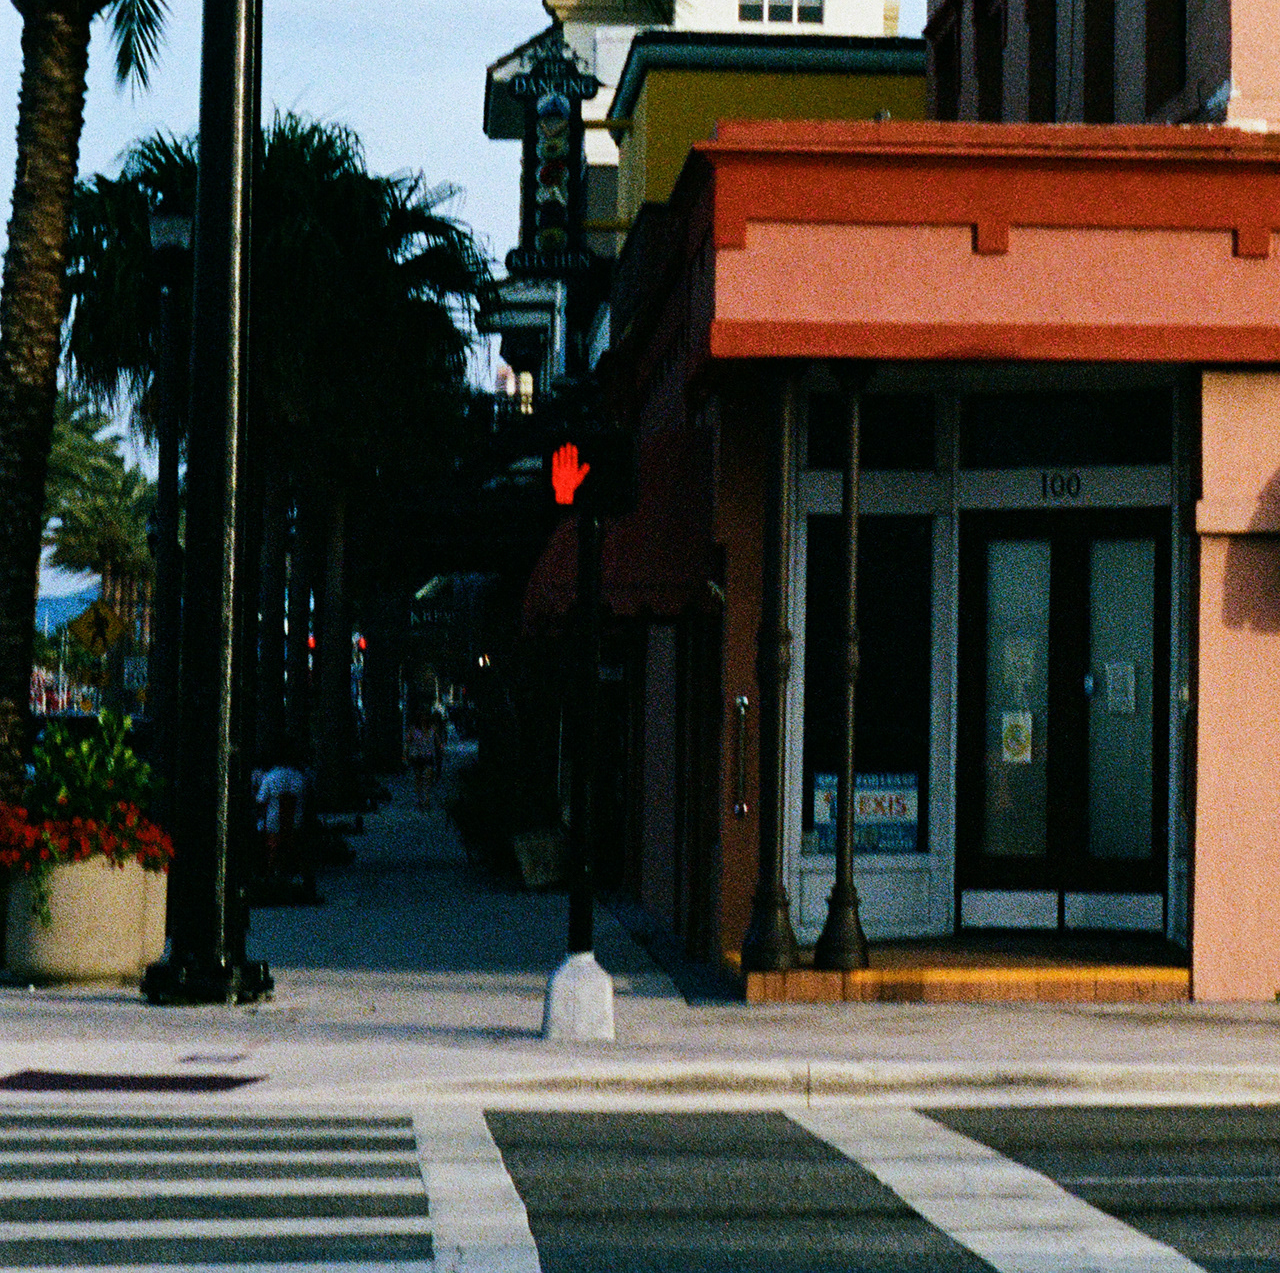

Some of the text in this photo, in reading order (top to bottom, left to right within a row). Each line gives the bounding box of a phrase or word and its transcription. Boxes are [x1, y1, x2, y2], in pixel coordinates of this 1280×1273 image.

[513, 75, 595, 96] DANCING
[511, 251, 591, 269] KITCHEN
[1041, 472, 1082, 499] 100
